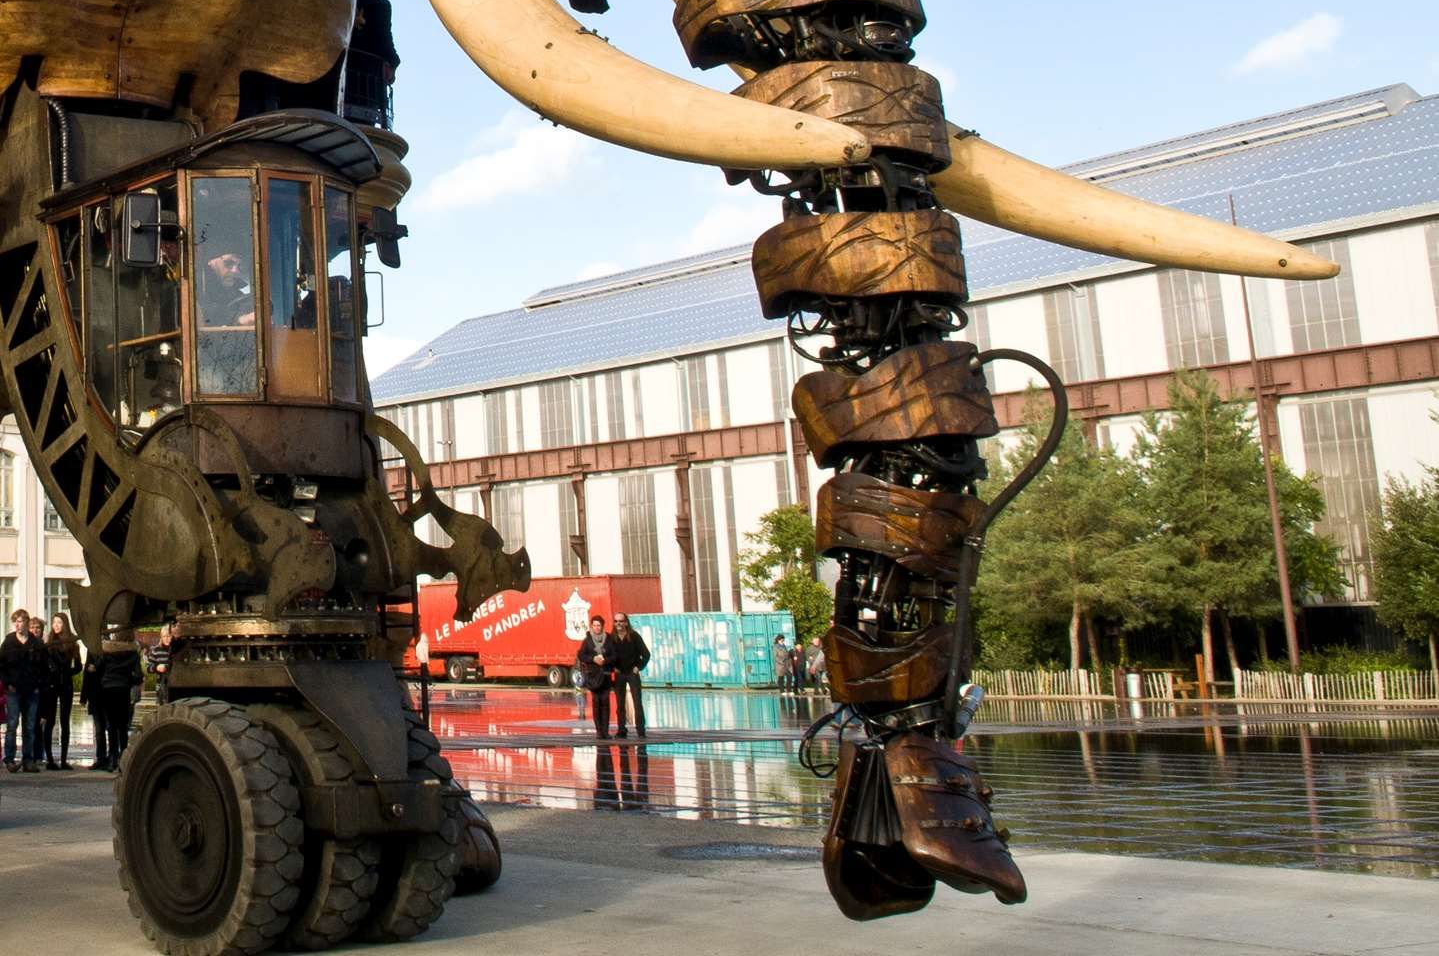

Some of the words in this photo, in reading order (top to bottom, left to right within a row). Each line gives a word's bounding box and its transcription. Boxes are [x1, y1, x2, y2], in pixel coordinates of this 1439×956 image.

[435, 622, 451, 643] LE
[453, 594, 505, 633] MNEGE
[482, 599, 546, 642] D'ANDREA
